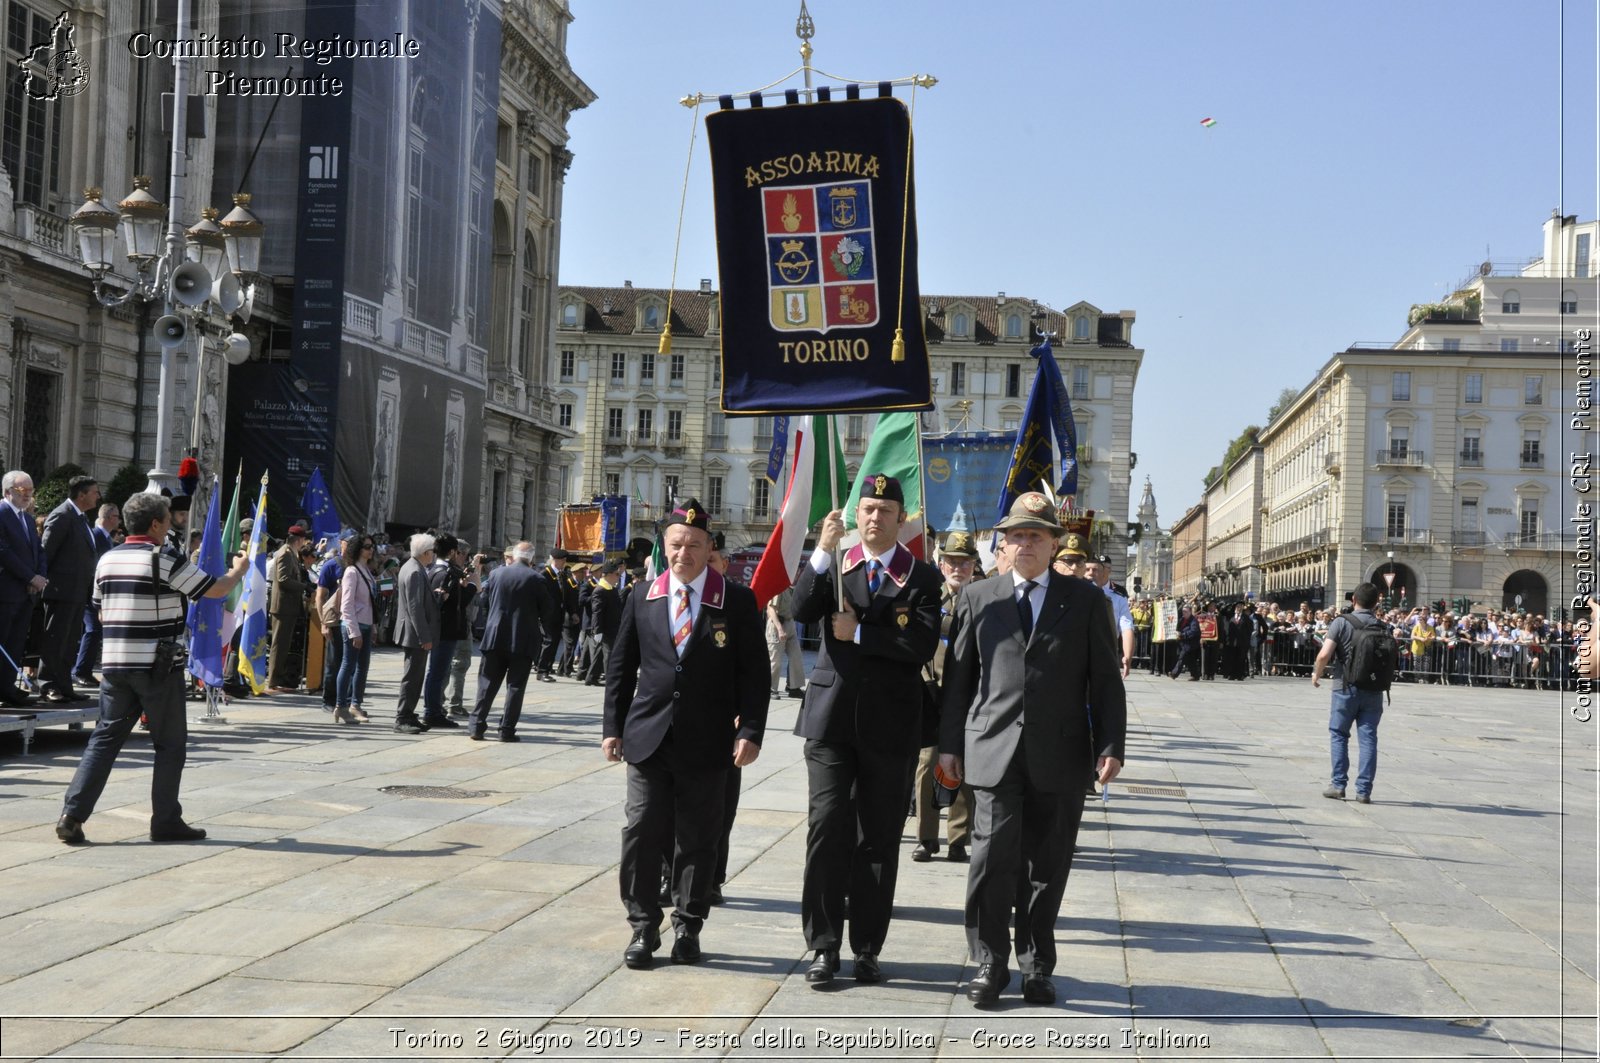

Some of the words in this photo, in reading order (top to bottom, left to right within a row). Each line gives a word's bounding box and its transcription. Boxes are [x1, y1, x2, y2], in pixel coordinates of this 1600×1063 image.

[744, 151, 880, 188] ASSOARMA
[778, 338, 869, 363] TORINO
[254, 399, 288, 411] Palazzo
[289, 401, 328, 413] Madama
